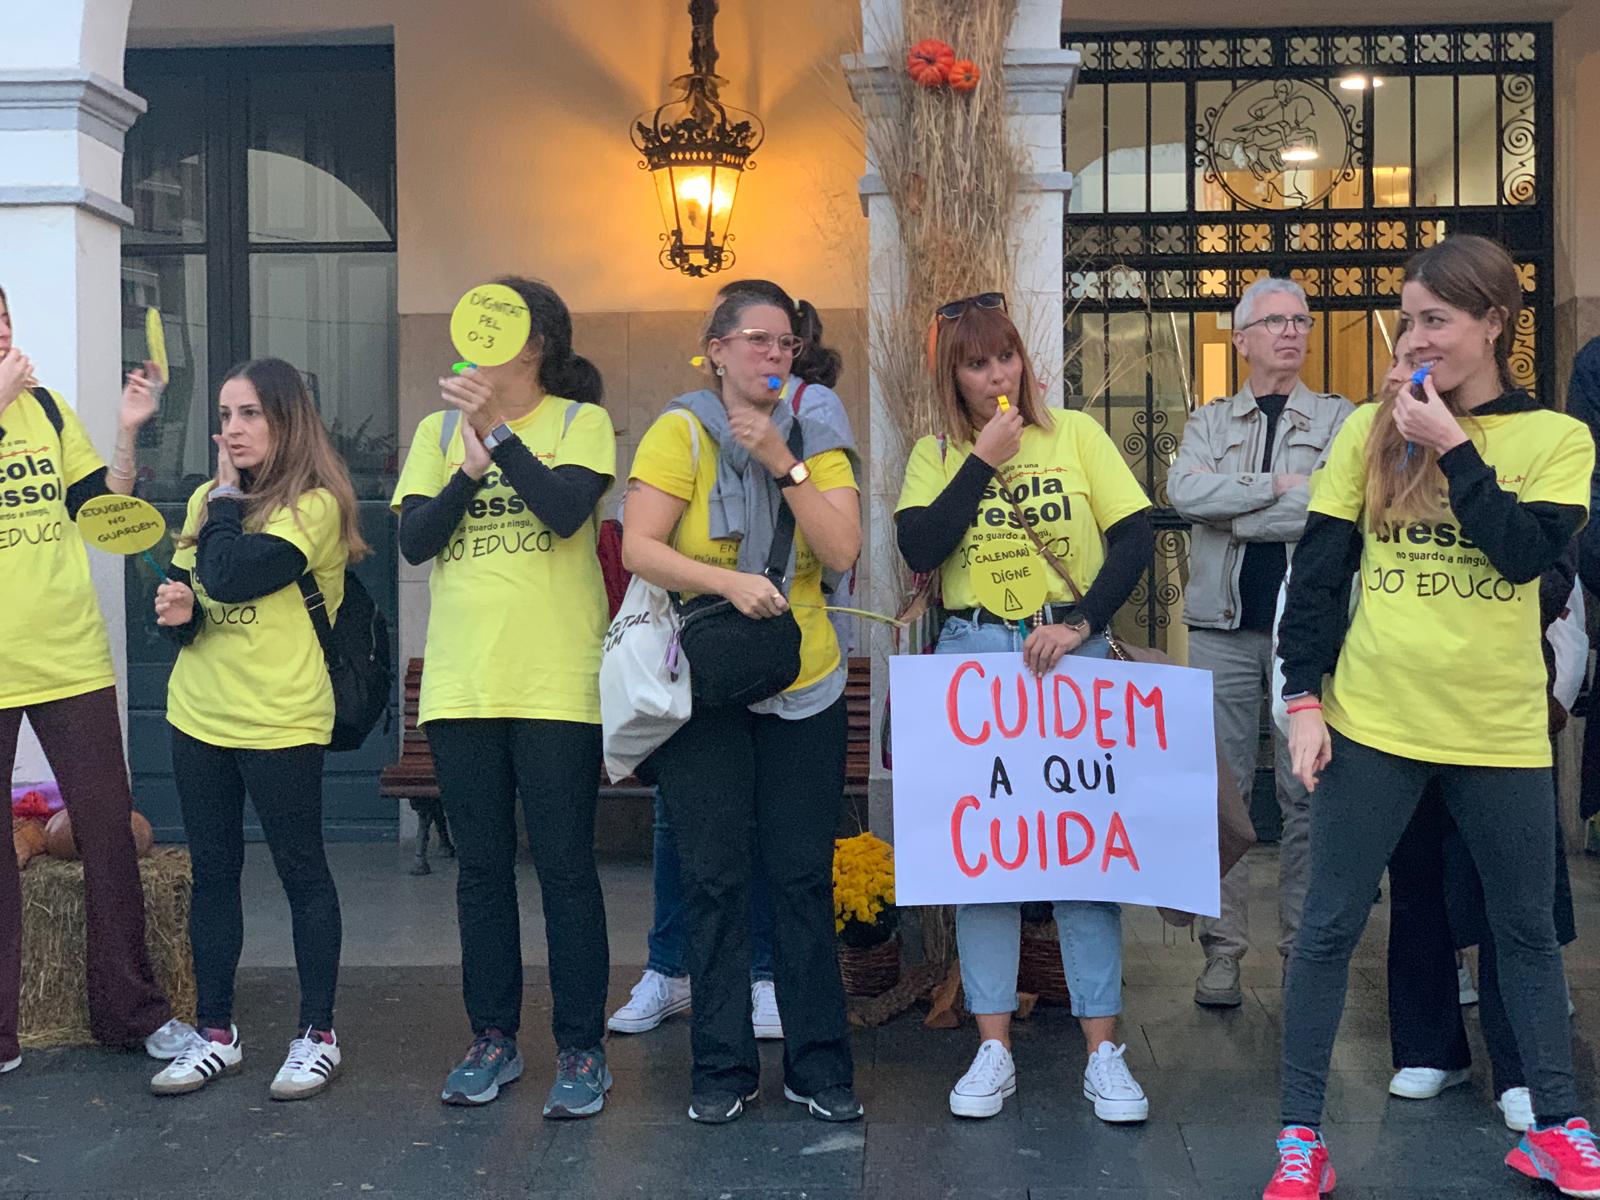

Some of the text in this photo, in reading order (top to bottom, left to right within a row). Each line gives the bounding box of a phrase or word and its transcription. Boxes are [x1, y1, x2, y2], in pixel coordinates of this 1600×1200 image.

[479, 314, 502, 331] PEL
[0, 477, 61, 507] ssol
[80, 501, 142, 518] EDUQUEM
[466, 494, 526, 519] ess
[97, 521, 159, 542] GUARDEM
[107, 515, 126, 526] NO
[468, 522, 498, 533] guardo
[472, 530, 555, 558] EDUCO.
[972, 532, 984, 541] no
[986, 532, 1018, 541] guardo
[1396, 551, 1490, 568] no guardo a ningú,
[1368, 567, 1522, 602] JO EDUCO.
[946, 660, 1168, 751] CUIDEM
[989, 756, 1013, 799] A
[951, 795, 1141, 879] CUIDA
